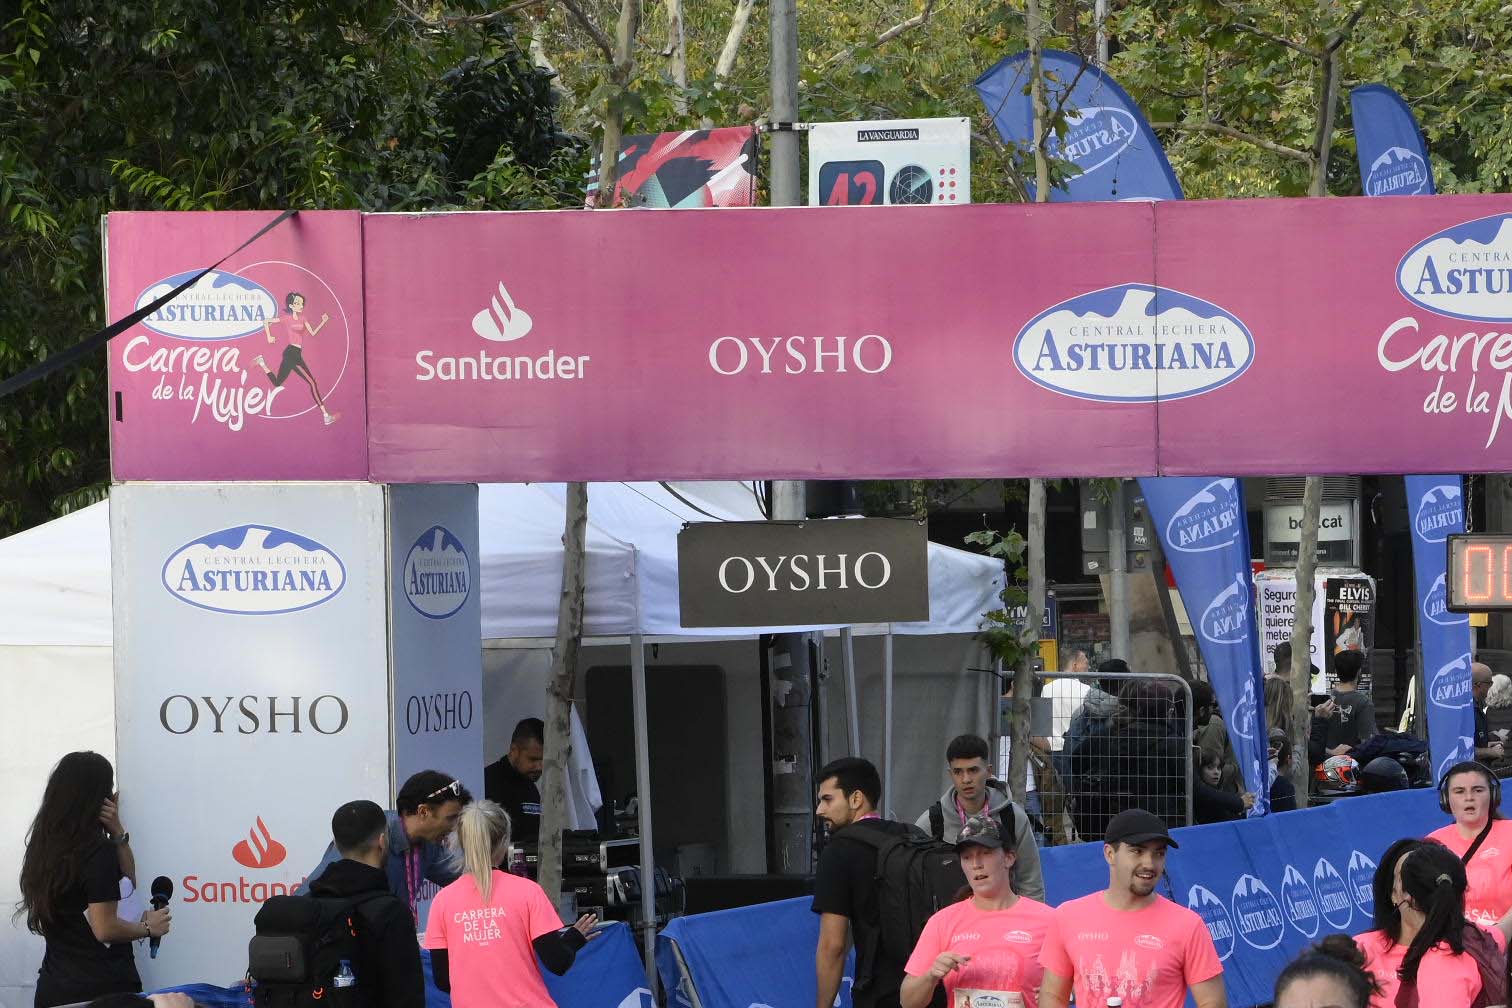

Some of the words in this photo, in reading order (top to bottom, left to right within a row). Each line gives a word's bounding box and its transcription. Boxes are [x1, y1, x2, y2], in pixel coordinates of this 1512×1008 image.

[1068, 325, 1146, 337] CENTRAL
[1152, 324, 1229, 336] LECHERA
[122, 335, 241, 373] Carrera
[415, 349, 591, 381] Santander
[708, 334, 893, 376] OYSHO
[1031, 328, 1238, 373] ASTURIANA
[152, 374, 175, 401] de
[178, 374, 195, 401] la
[190, 370, 286, 432] Mujer
[1423, 375, 1458, 414] de
[1465, 373, 1491, 414] la
[176, 558, 334, 593] ASTURIANA
[203, 556, 263, 566] CENTRAL
[267, 555, 327, 566] LECHERA
[408, 560, 467, 596] ASTURIANA
[717, 551, 892, 593] OYSHO
[1264, 604, 1278, 617] que
[1339, 587, 1370, 600] ELVIS
[159, 694, 350, 735] OYSHO
[405, 690, 474, 736] OYSHO
[454, 907, 507, 924] CARRERA
[464, 921, 479, 932] DE
[483, 918, 498, 929] LA
[463, 928, 502, 944] MUJER
